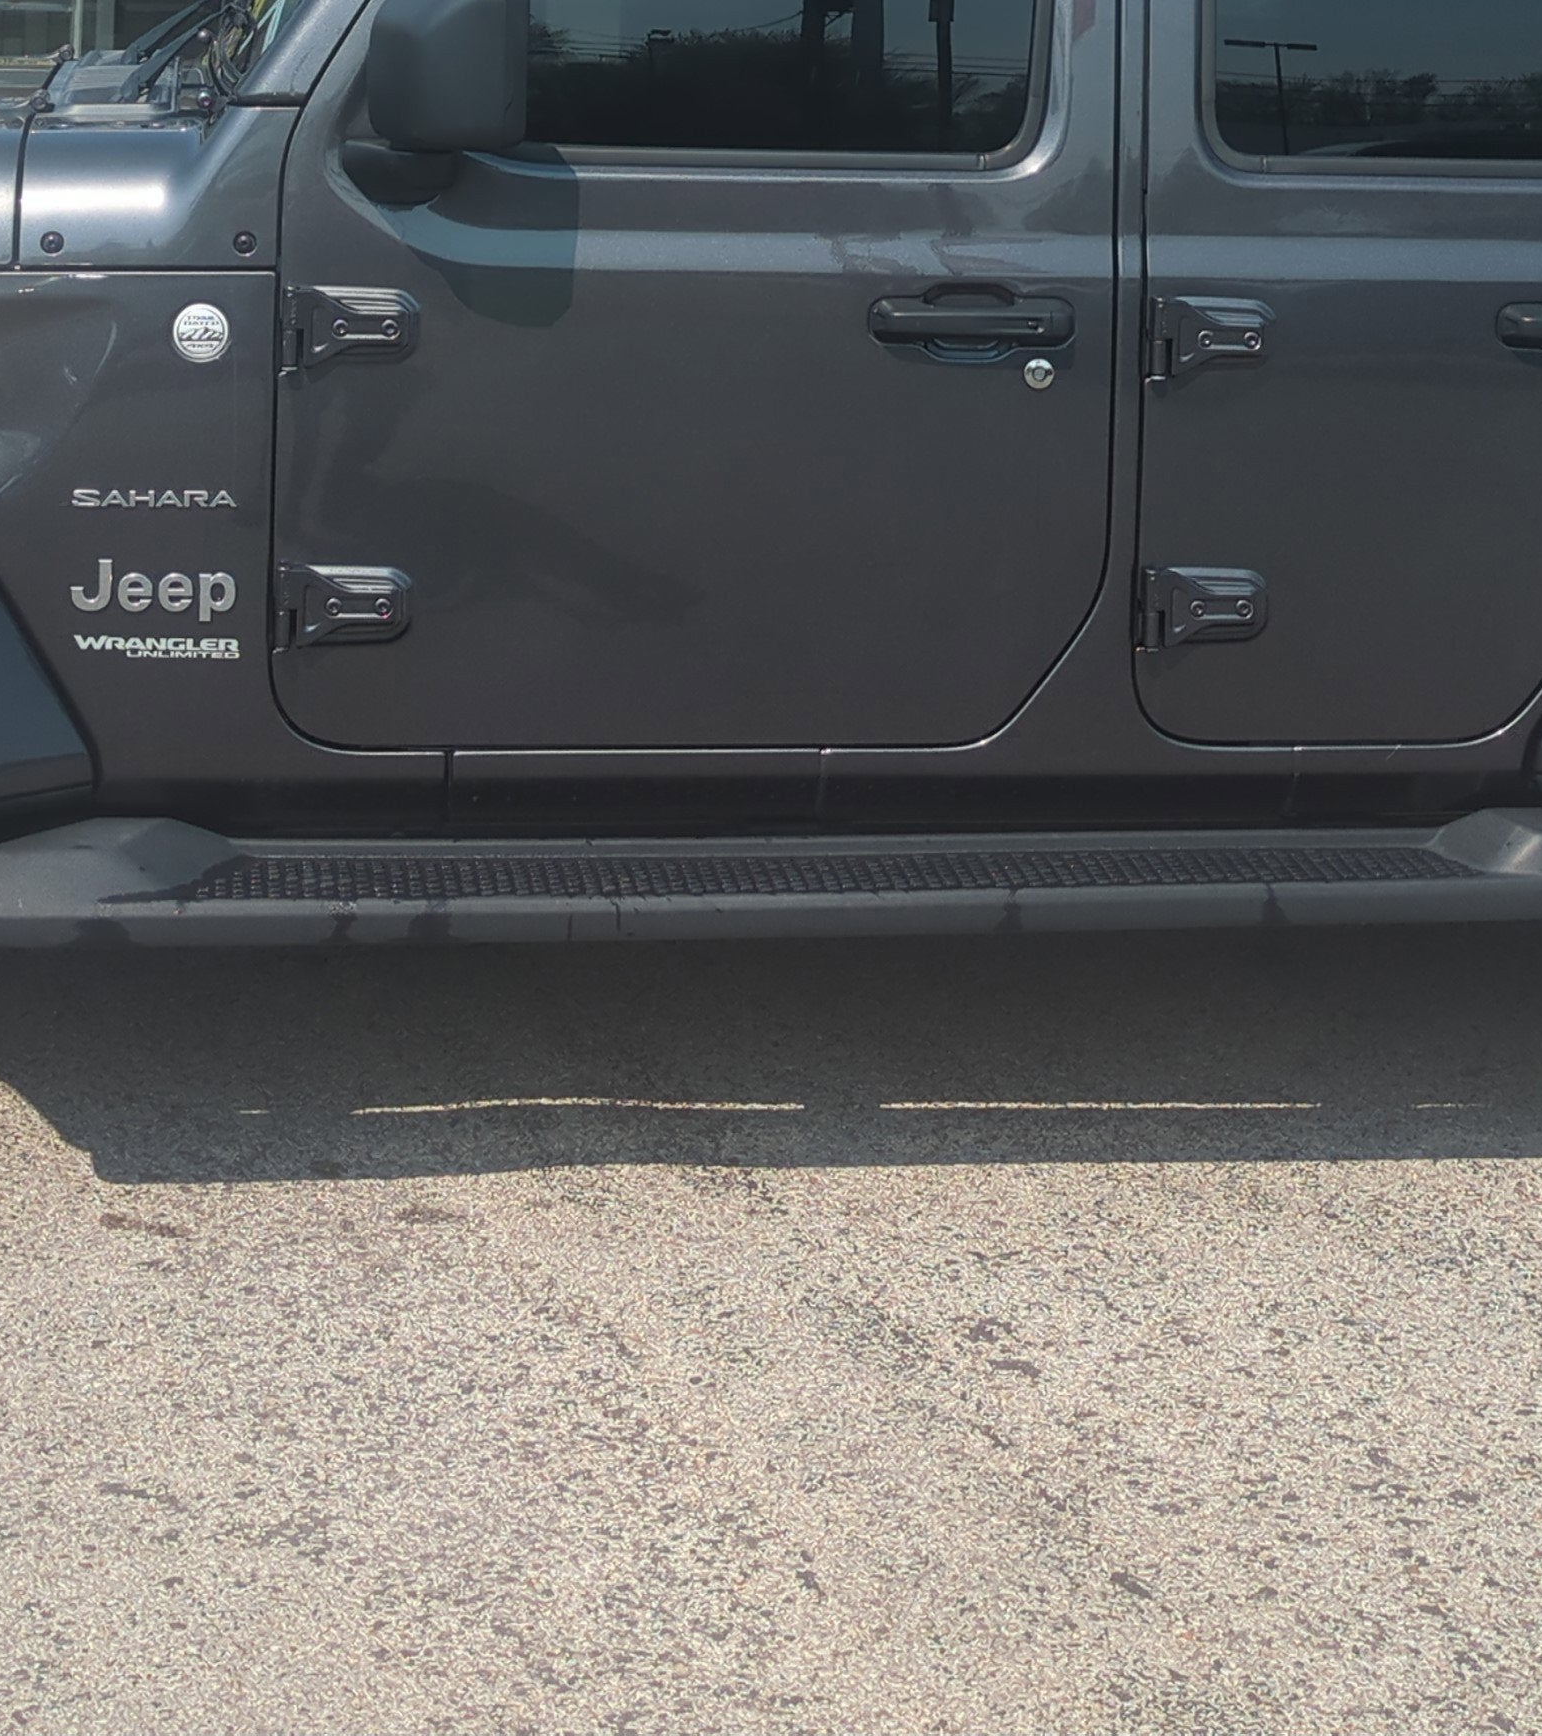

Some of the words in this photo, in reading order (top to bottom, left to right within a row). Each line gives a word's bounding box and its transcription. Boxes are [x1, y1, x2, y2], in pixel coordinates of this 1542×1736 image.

[71, 488, 237, 508] SAHARA
[69, 558, 237, 622] Jeep
[73, 634, 241, 652] WRANGLER
[126, 650, 241, 660] UNLIMITED
